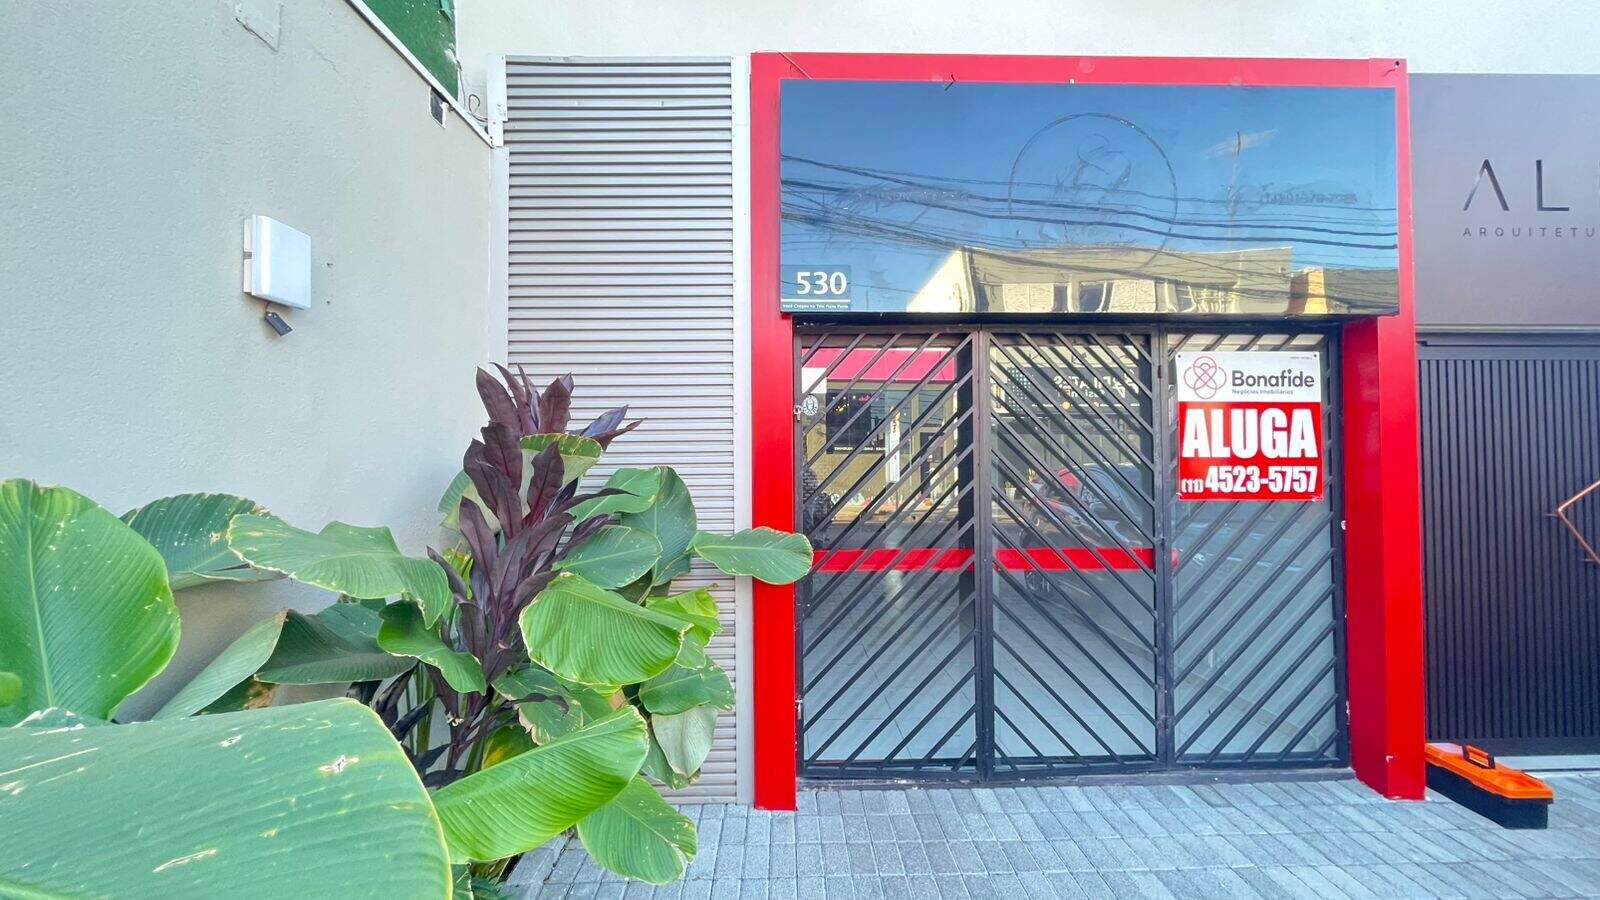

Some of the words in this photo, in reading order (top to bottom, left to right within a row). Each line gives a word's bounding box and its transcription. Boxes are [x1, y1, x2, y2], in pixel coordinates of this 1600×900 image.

[1462, 226, 1597, 238] ARQUITETU
[797, 271, 847, 295] 530
[1231, 369, 1315, 387] Bonafide
[1181, 408, 1319, 459] ALUGA
[1205, 465, 1318, 493] 4523-5757
